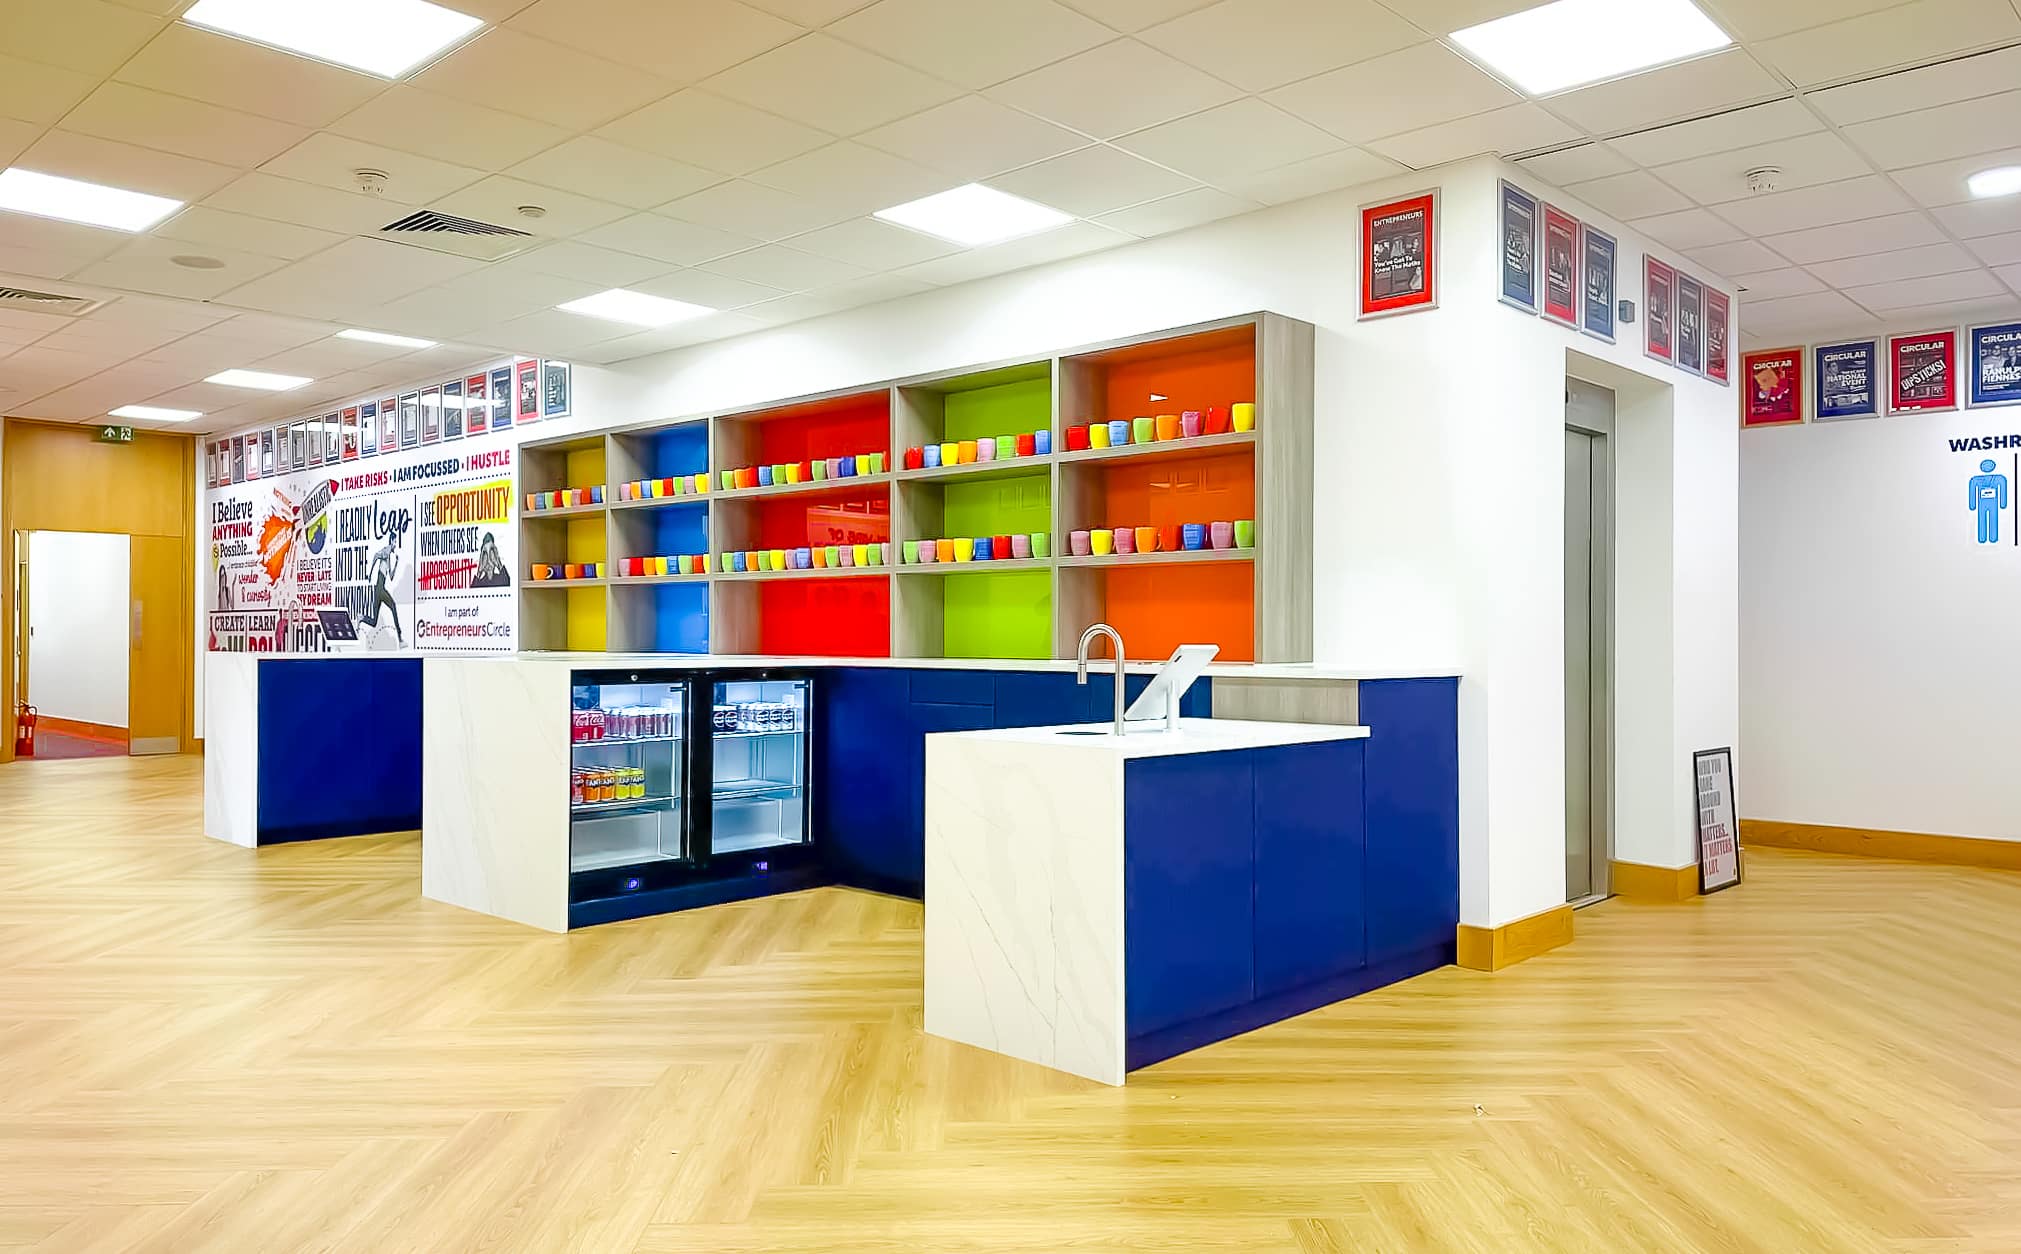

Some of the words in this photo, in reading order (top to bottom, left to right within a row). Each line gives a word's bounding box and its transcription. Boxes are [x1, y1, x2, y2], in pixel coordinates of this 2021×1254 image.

[1900, 341, 1945, 353] CIRCULAR
[1753, 360, 1792, 370] CIRCULAR
[1824, 351, 1866, 362] CIRCULAR
[1826, 372, 1867, 383] NATIONAL
[1842, 378, 1867, 387] EVENT
[1948, 434, 2021, 453] WASHR
[345, 474, 364, 490] TAKE
[366, 470, 388, 487] RISKS
[398, 466, 412, 481] AM
[412, 458, 460, 480] FOCUSSED
[471, 450, 510, 470] HUSTLE
[219, 497, 252, 522] Believe
[424, 500, 435, 526] SEE
[436, 486, 510, 526] OPPORTUNITY
[212, 522, 252, 541] ANYTHING
[340, 504, 372, 543] READILY
[374, 499, 412, 548] leap
[420, 530, 440, 557] WHEN
[440, 528, 465, 555] OTHERS
[466, 526, 478, 552] SEE
[300, 558, 320, 571] BELIEVE
[335, 547, 352, 582] INTO
[354, 546, 368, 581] THE
[297, 572, 314, 583] NEVER
[318, 570, 332, 581] LATE
[420, 558, 473, 591] IMPOSSIBILITY
[306, 592, 332, 606] DREAM
[335, 585, 376, 620] UNKNOWN
[458, 606, 470, 619] part
[471, 605, 479, 616] of
[214, 616, 244, 632] CREATE
[248, 615, 276, 632] LEARN
